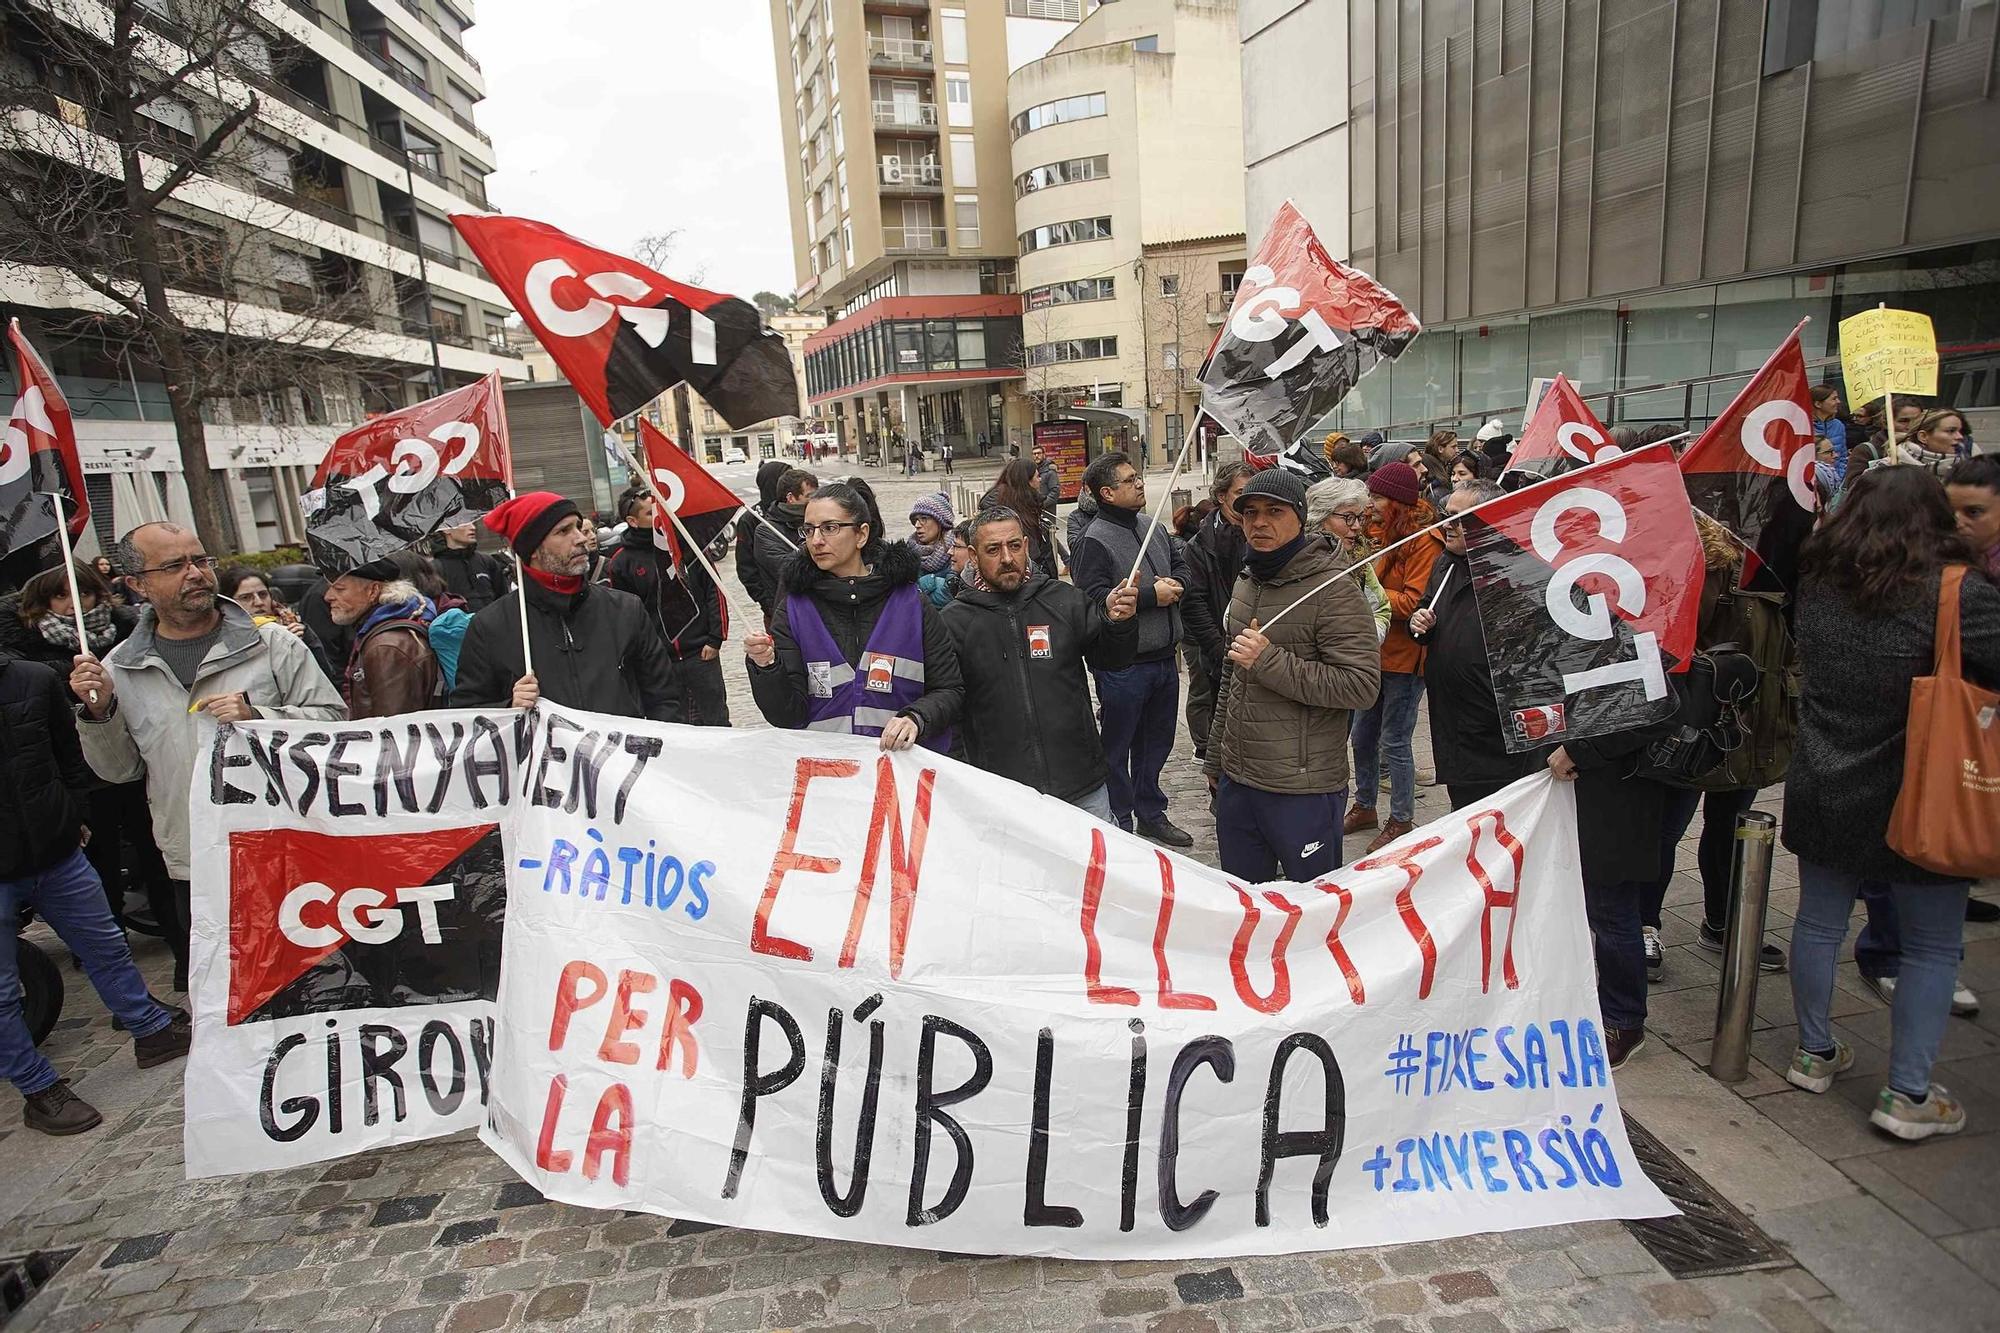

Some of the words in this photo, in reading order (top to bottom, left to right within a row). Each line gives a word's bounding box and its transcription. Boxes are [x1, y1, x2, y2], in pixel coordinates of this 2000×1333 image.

[1531, 486, 1668, 703] CGT
[869, 680, 888, 688] CGT
[1032, 649, 1049, 657] CGT
[1514, 712, 1530, 738] CGT
[1304, 841, 1320, 852] NIKE
[279, 882, 455, 948] CGT
[750, 754, 936, 980] EN
[1080, 808, 1524, 1015] LLUITA
[548, 960, 704, 1079] PER
[535, 1073, 633, 1187] LA
